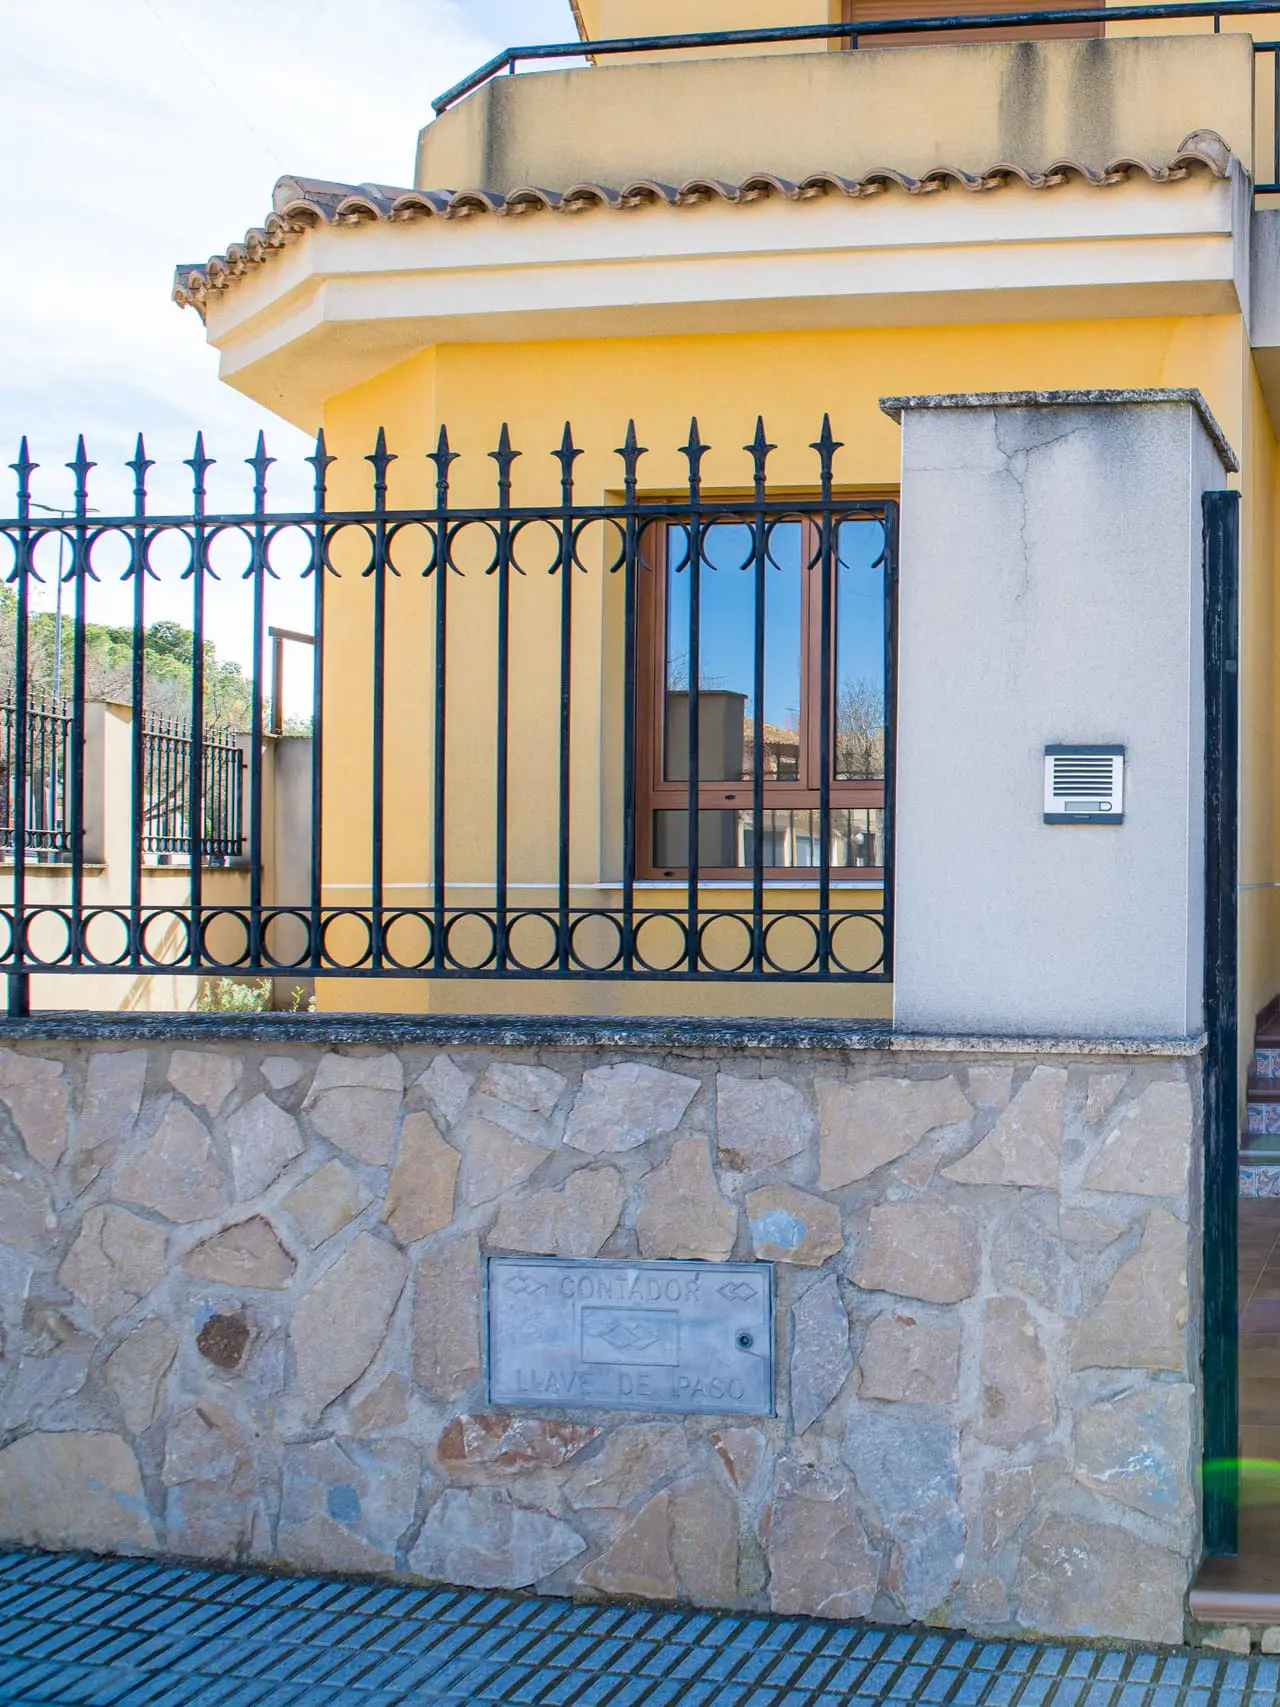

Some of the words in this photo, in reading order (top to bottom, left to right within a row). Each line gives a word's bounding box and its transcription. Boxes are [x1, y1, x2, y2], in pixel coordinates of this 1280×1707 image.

[560, 1274, 701, 1302] CONTADOR
[515, 1368, 594, 1395] LLAVE
[617, 1371, 652, 1396] DE
[675, 1375, 744, 1400] PASO
